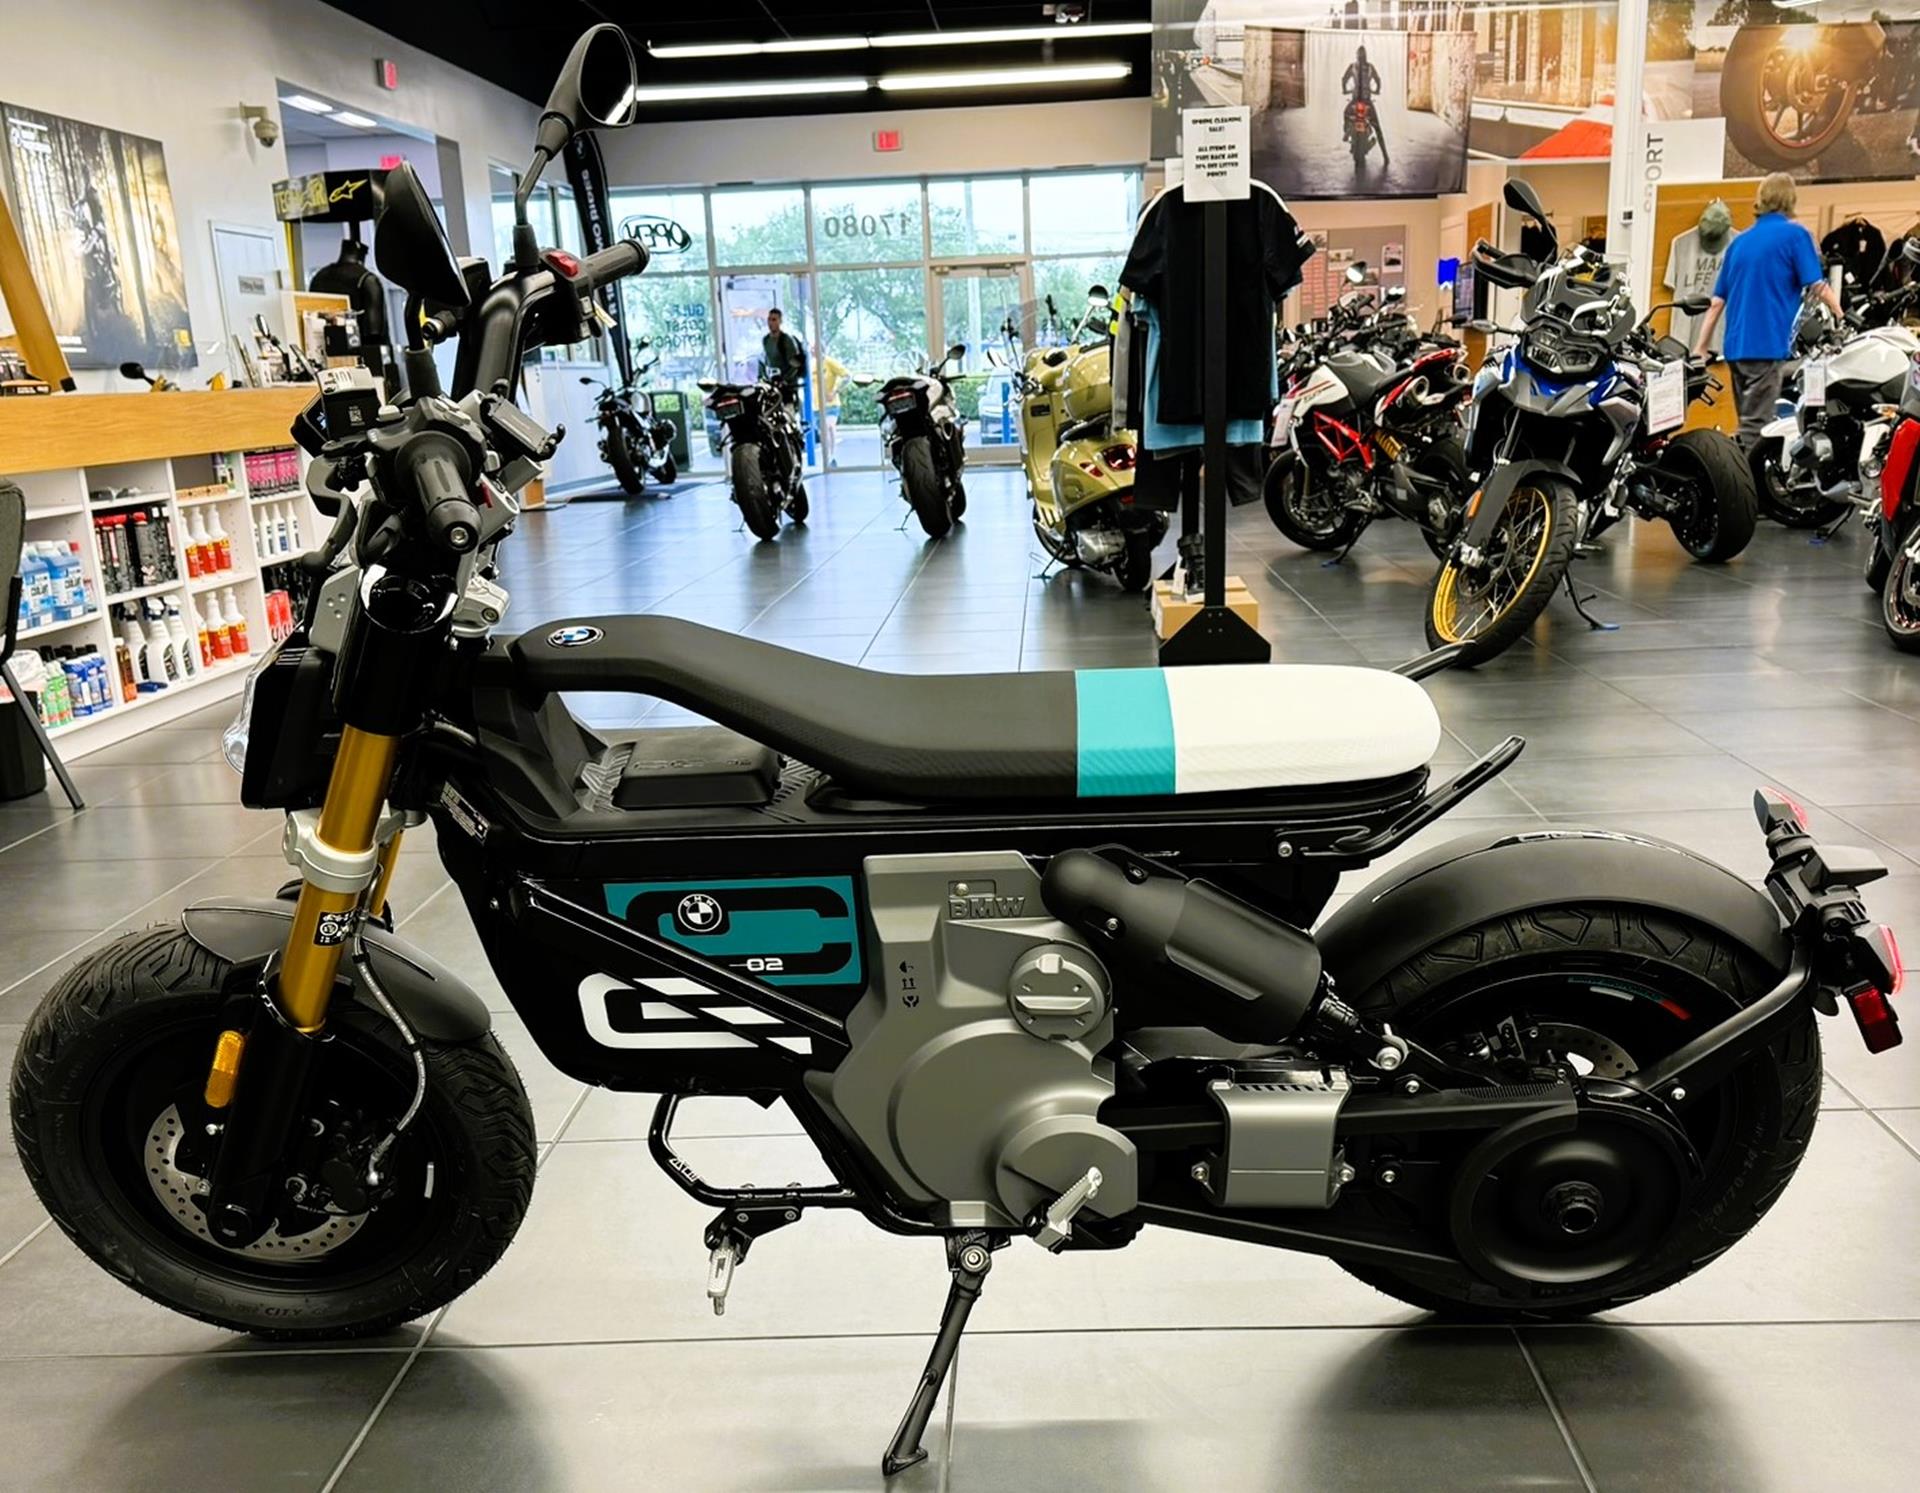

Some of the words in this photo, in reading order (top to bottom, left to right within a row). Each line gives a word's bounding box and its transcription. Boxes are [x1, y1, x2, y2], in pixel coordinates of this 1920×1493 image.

[1214, 116, 1242, 124] CLEANING
[948, 896, 1025, 919] BMW
[746, 957, 784, 972] 02
[264, 1307, 302, 1317] CITY
